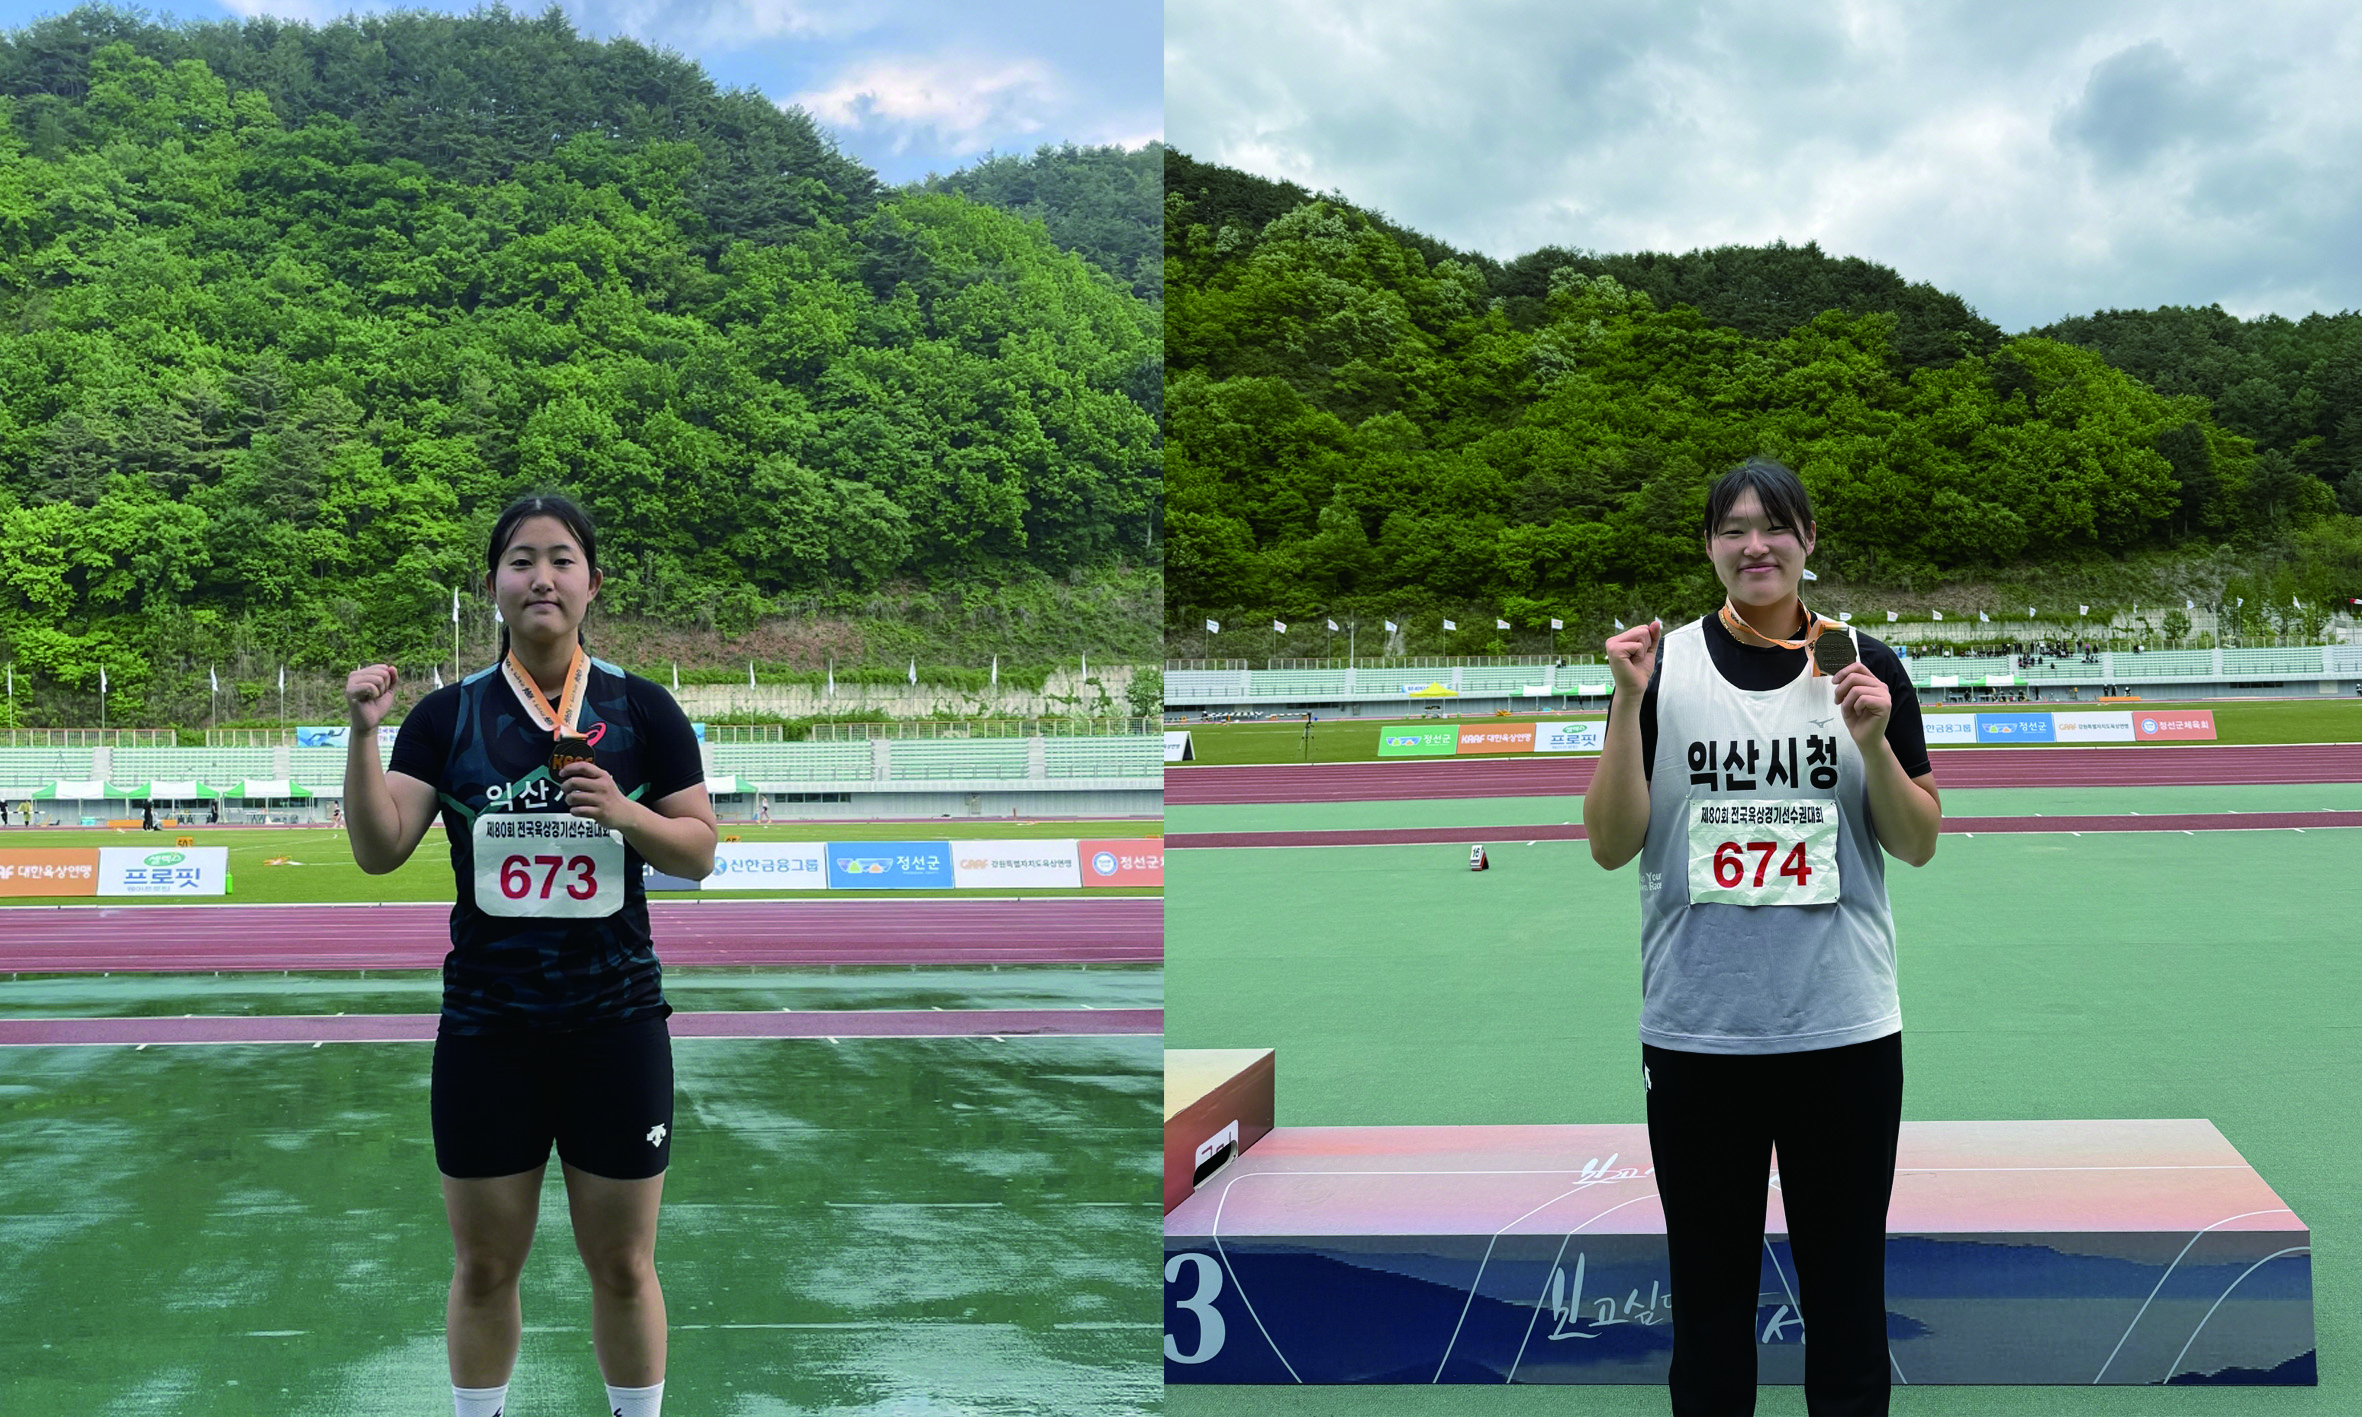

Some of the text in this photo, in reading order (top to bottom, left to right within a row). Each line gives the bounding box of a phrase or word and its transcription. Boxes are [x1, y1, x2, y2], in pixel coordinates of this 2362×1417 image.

[2159, 720, 2209, 731] 정선군체육회
[1423, 734, 1451, 746] 정선군
[1550, 734, 1597, 747] 프로핏
[1687, 734, 1838, 792] 익산시청
[485, 779, 565, 811] 익산
[1700, 806, 1824, 824] 제80회 전국육상경기선수권대회
[486, 821, 515, 839] 제80회
[17, 864, 92, 879] 대한육상연맹
[729, 858, 819, 873] 신한금융그룹
[896, 855, 940, 871] 정선군
[1713, 841, 1812, 888] 674
[123, 867, 201, 888] 프로핏
[500, 854, 598, 900] 673
[1164, 1252, 1226, 1365] 3
